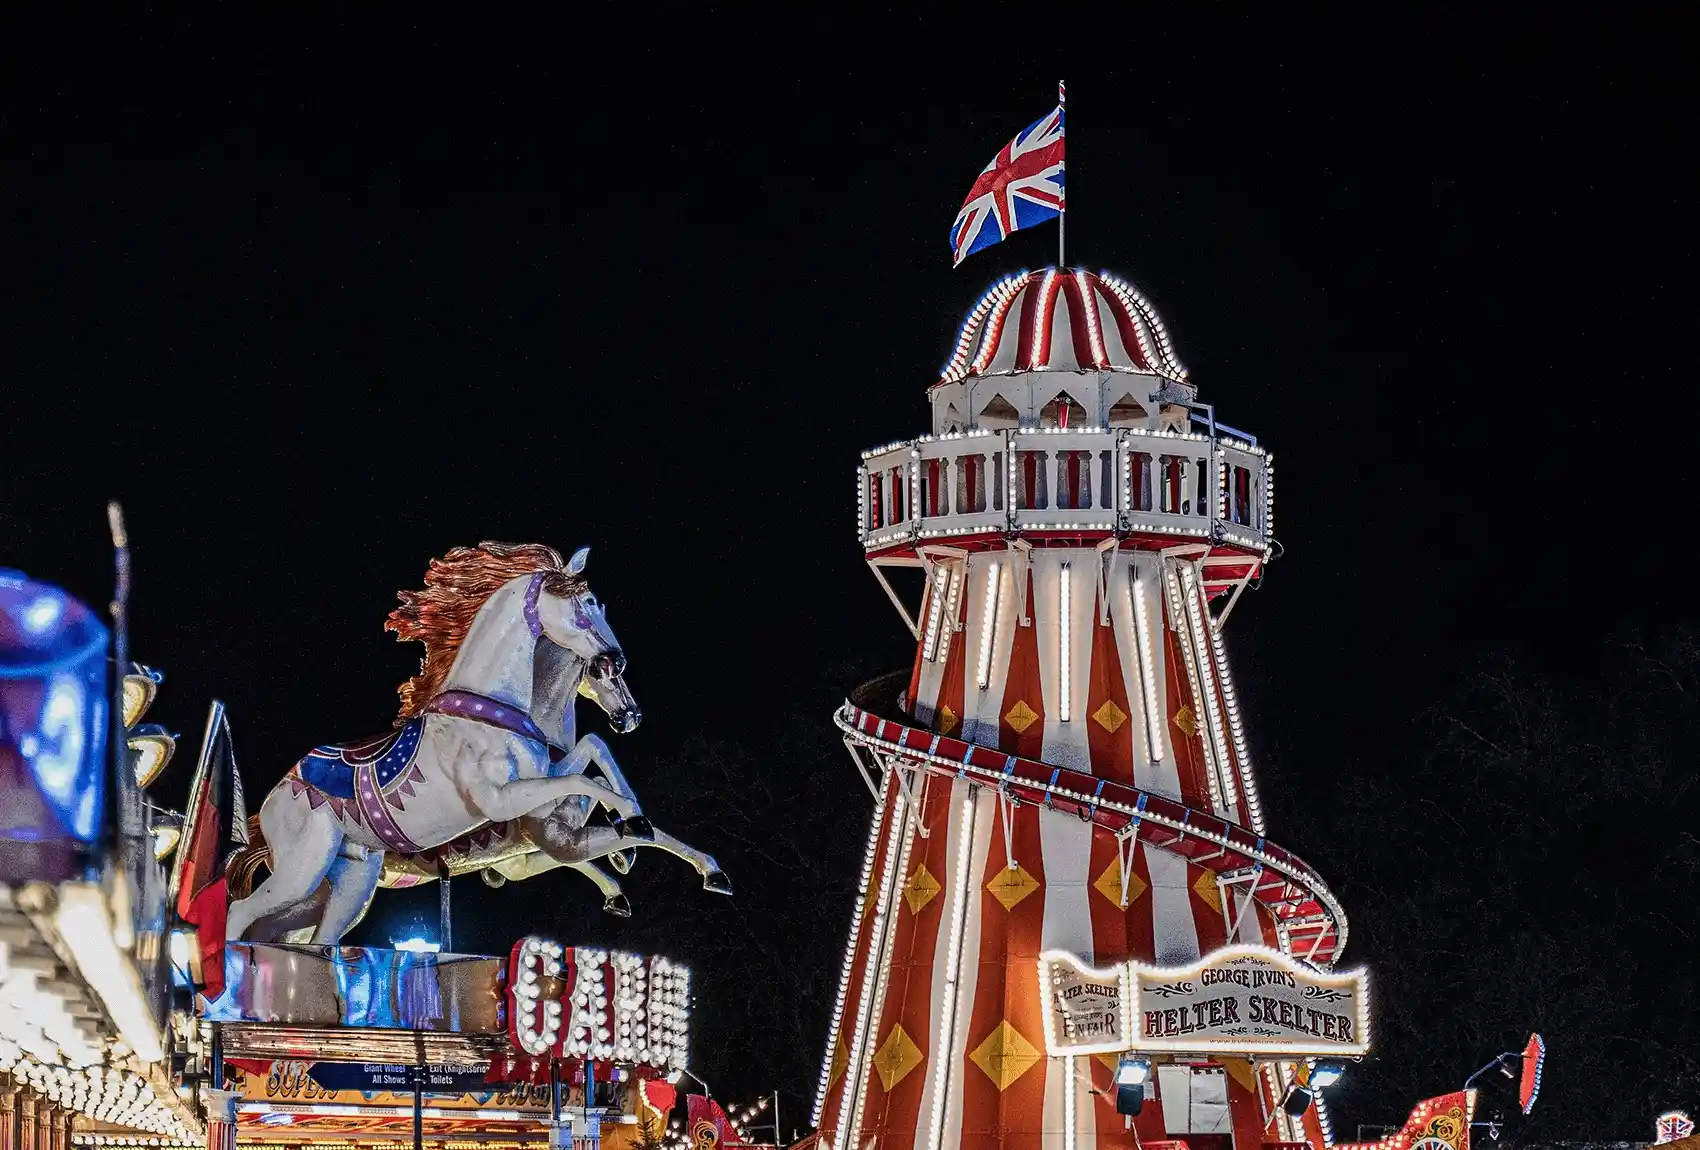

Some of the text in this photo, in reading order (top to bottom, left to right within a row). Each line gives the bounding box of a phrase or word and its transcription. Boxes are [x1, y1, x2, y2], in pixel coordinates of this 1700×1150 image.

[1201, 968, 1296, 989] GEORGE IRVIN'S
[1053, 983, 1119, 1004] HLTER SKELTER
[1144, 994, 1354, 1043] HELTER SKELTER
[363, 1063, 406, 1073] Giant Wheel
[429, 1064, 443, 1073] Exit
[372, 1074, 406, 1084] All Shows
[429, 1074, 453, 1085] Toilets
